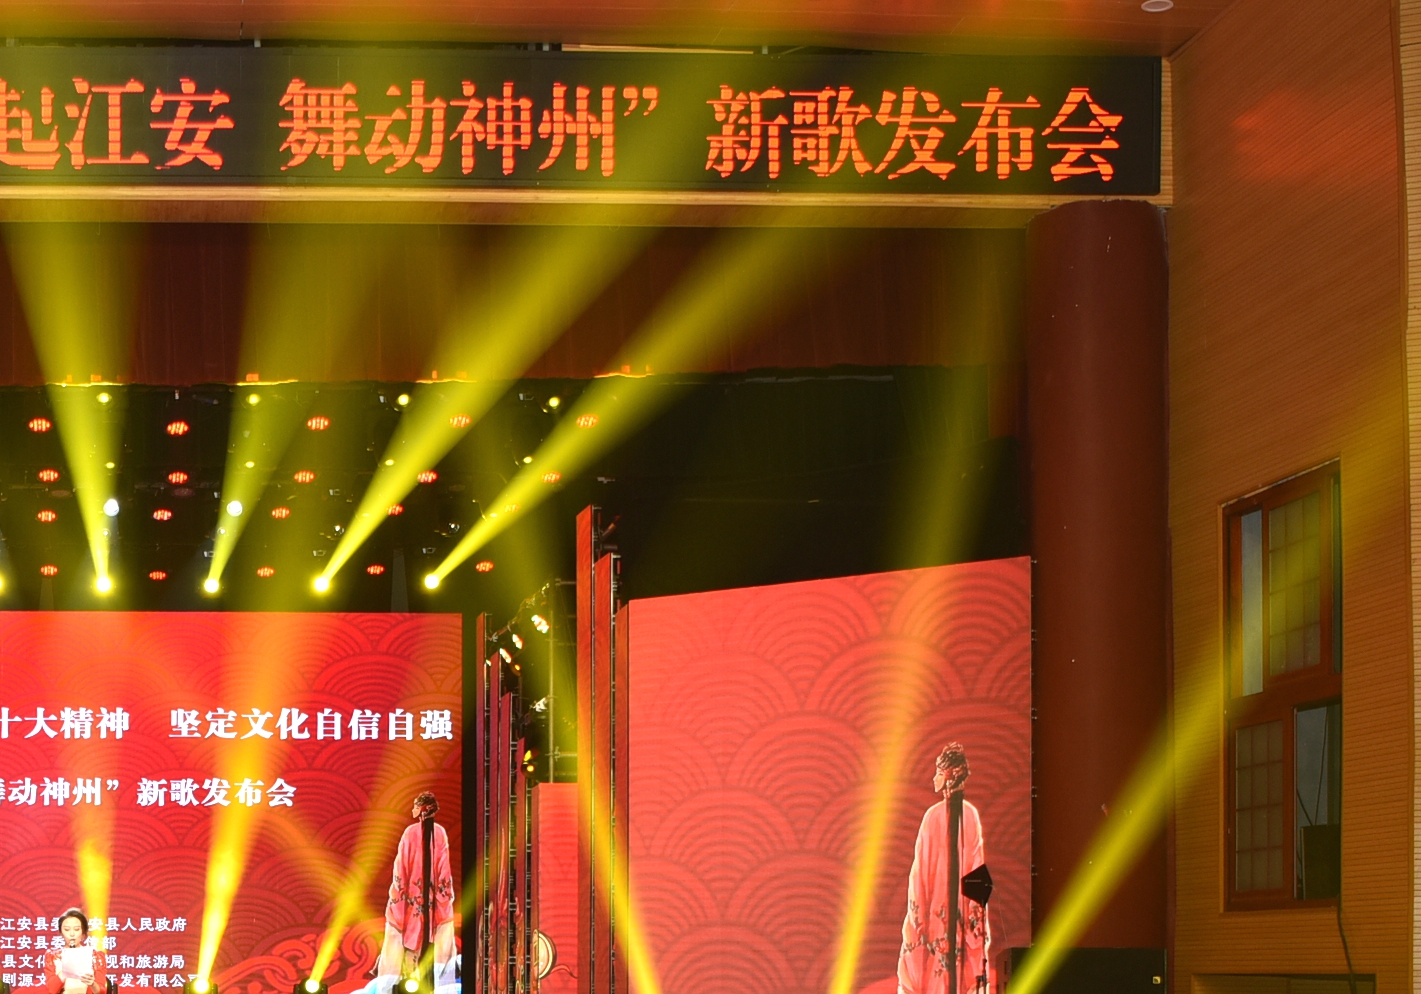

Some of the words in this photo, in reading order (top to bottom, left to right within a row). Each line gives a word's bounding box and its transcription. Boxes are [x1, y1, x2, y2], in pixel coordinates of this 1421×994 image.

[705, 85, 1123, 182] 新歌发布会
[169, 708, 454, 741] 坚定文化自信自强
[136, 777, 297, 807] 新歌发布会
